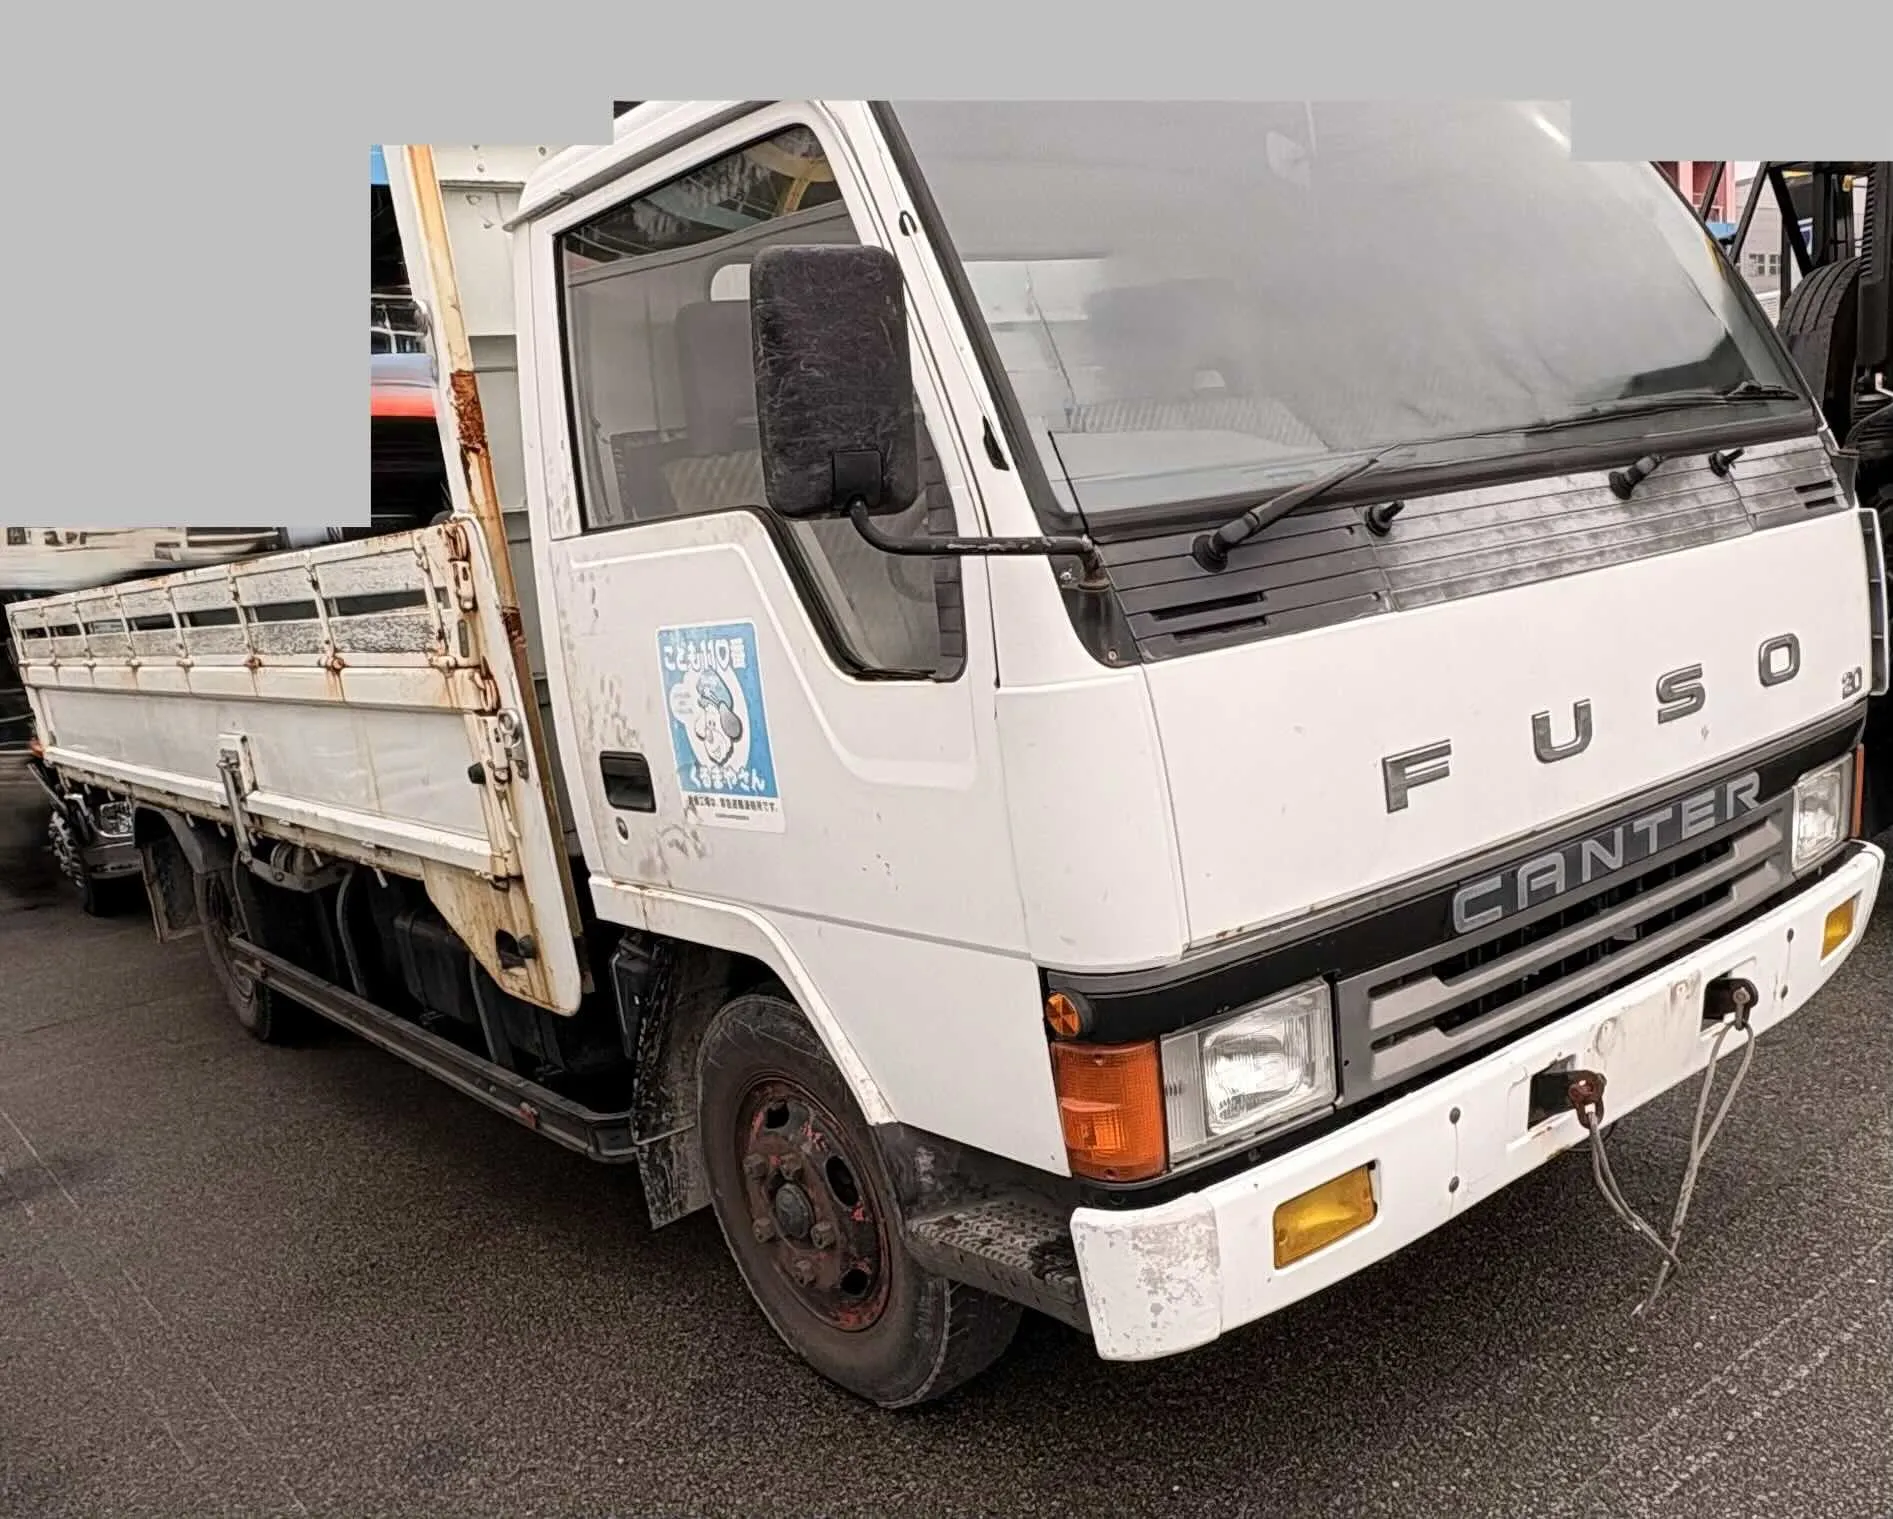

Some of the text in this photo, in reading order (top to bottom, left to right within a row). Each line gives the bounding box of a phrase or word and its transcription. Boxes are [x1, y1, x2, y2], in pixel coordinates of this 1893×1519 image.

[663, 638, 746, 672] こども110番
[1381, 632, 1801, 814] FUSO
[690, 765, 766, 794] くるまやさん
[1452, 770, 1763, 935] CANTER
